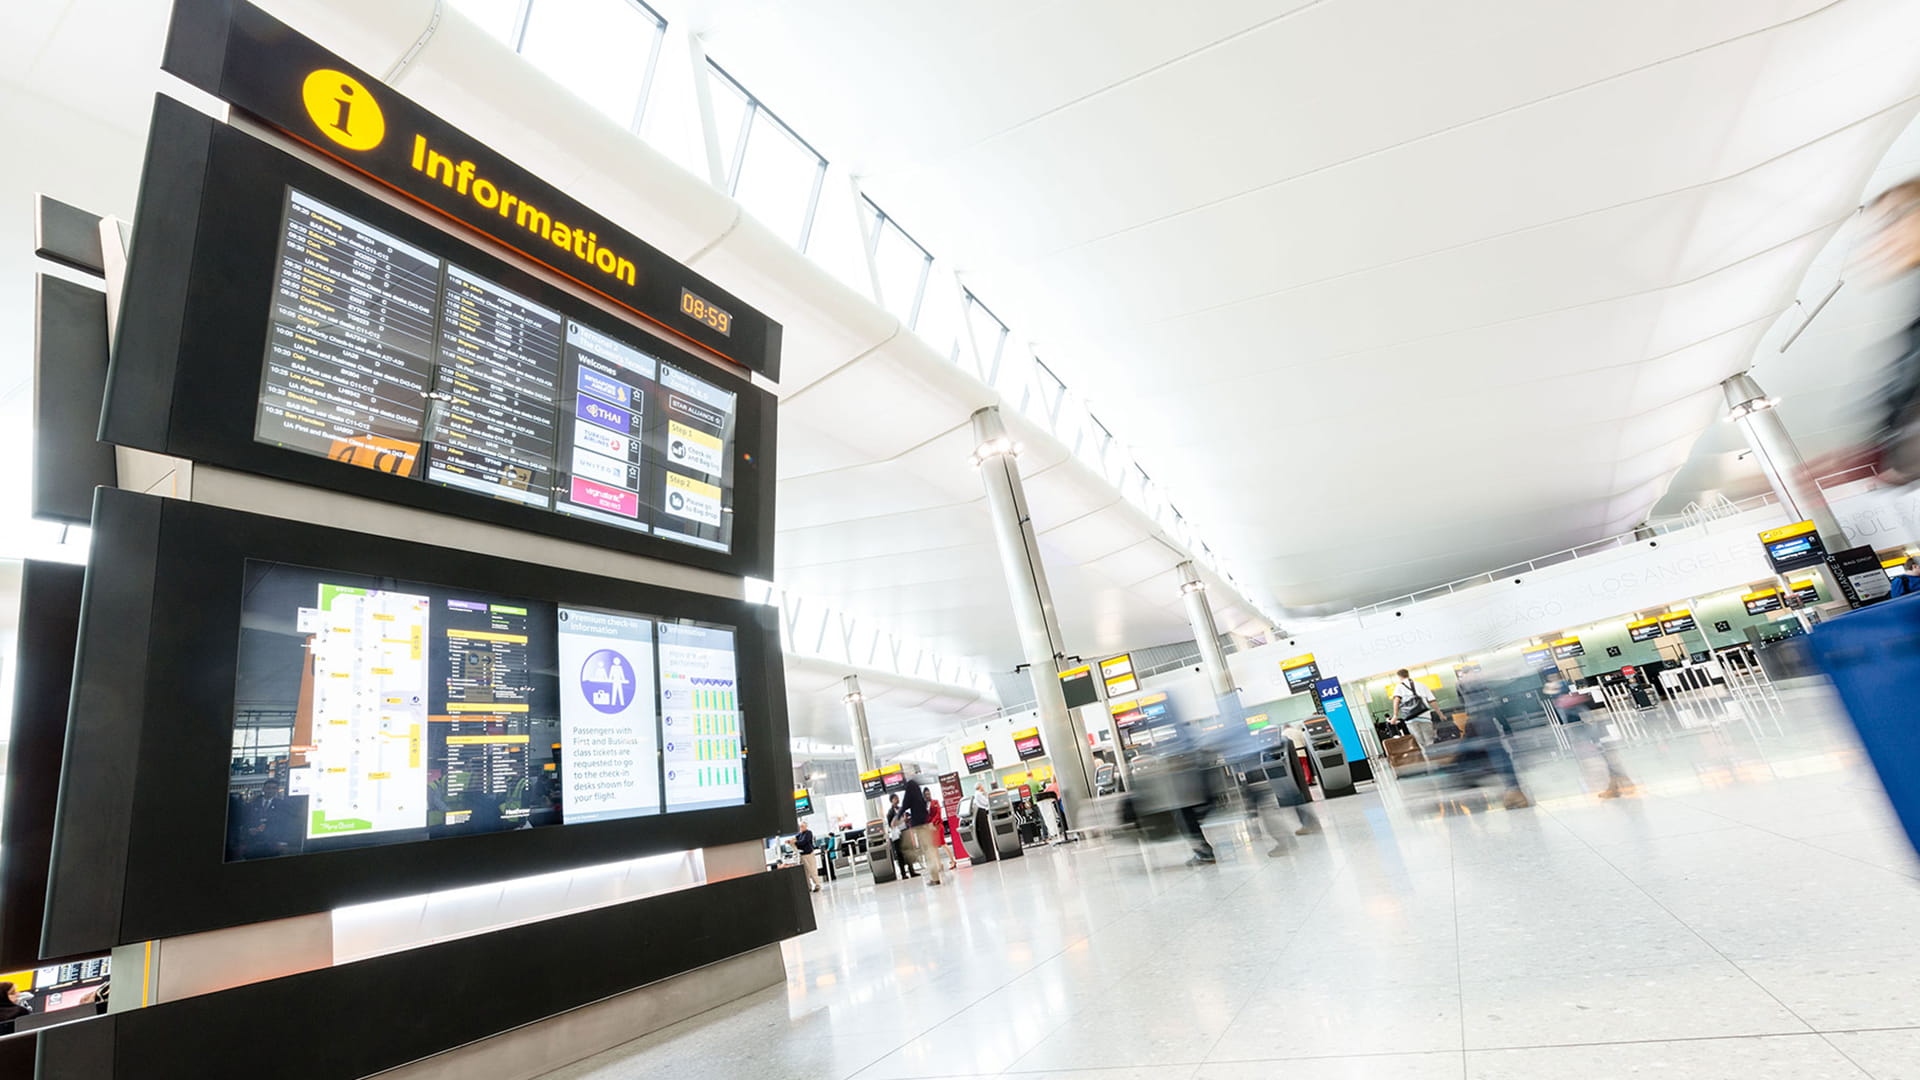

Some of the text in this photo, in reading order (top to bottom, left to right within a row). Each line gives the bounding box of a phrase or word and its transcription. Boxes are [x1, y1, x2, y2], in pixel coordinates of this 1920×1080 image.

[411, 133, 637, 287] Information
[682, 293, 729, 333] 08:59
[578, 354, 617, 375] Welcomes
[598, 407, 621, 425] THAI
[673, 399, 713, 422] STAR ALLIANCE
[672, 423, 686, 436] Step
[579, 459, 611, 474] UNITED
[670, 475, 684, 486] Step
[1589, 568, 1640, 598] LOS
[1831, 562, 1858, 601] ALLIANCE
[571, 612, 605, 625] Premium
[1321, 686, 1339, 698] SAS
[573, 726, 614, 736] Passengers
[593, 748, 616, 756] tickets
[573, 759, 612, 770] requested
[599, 768, 629, 777] check-in
[574, 782, 594, 791] desks
[597, 780, 621, 789] shown
[574, 794, 591, 804] your
